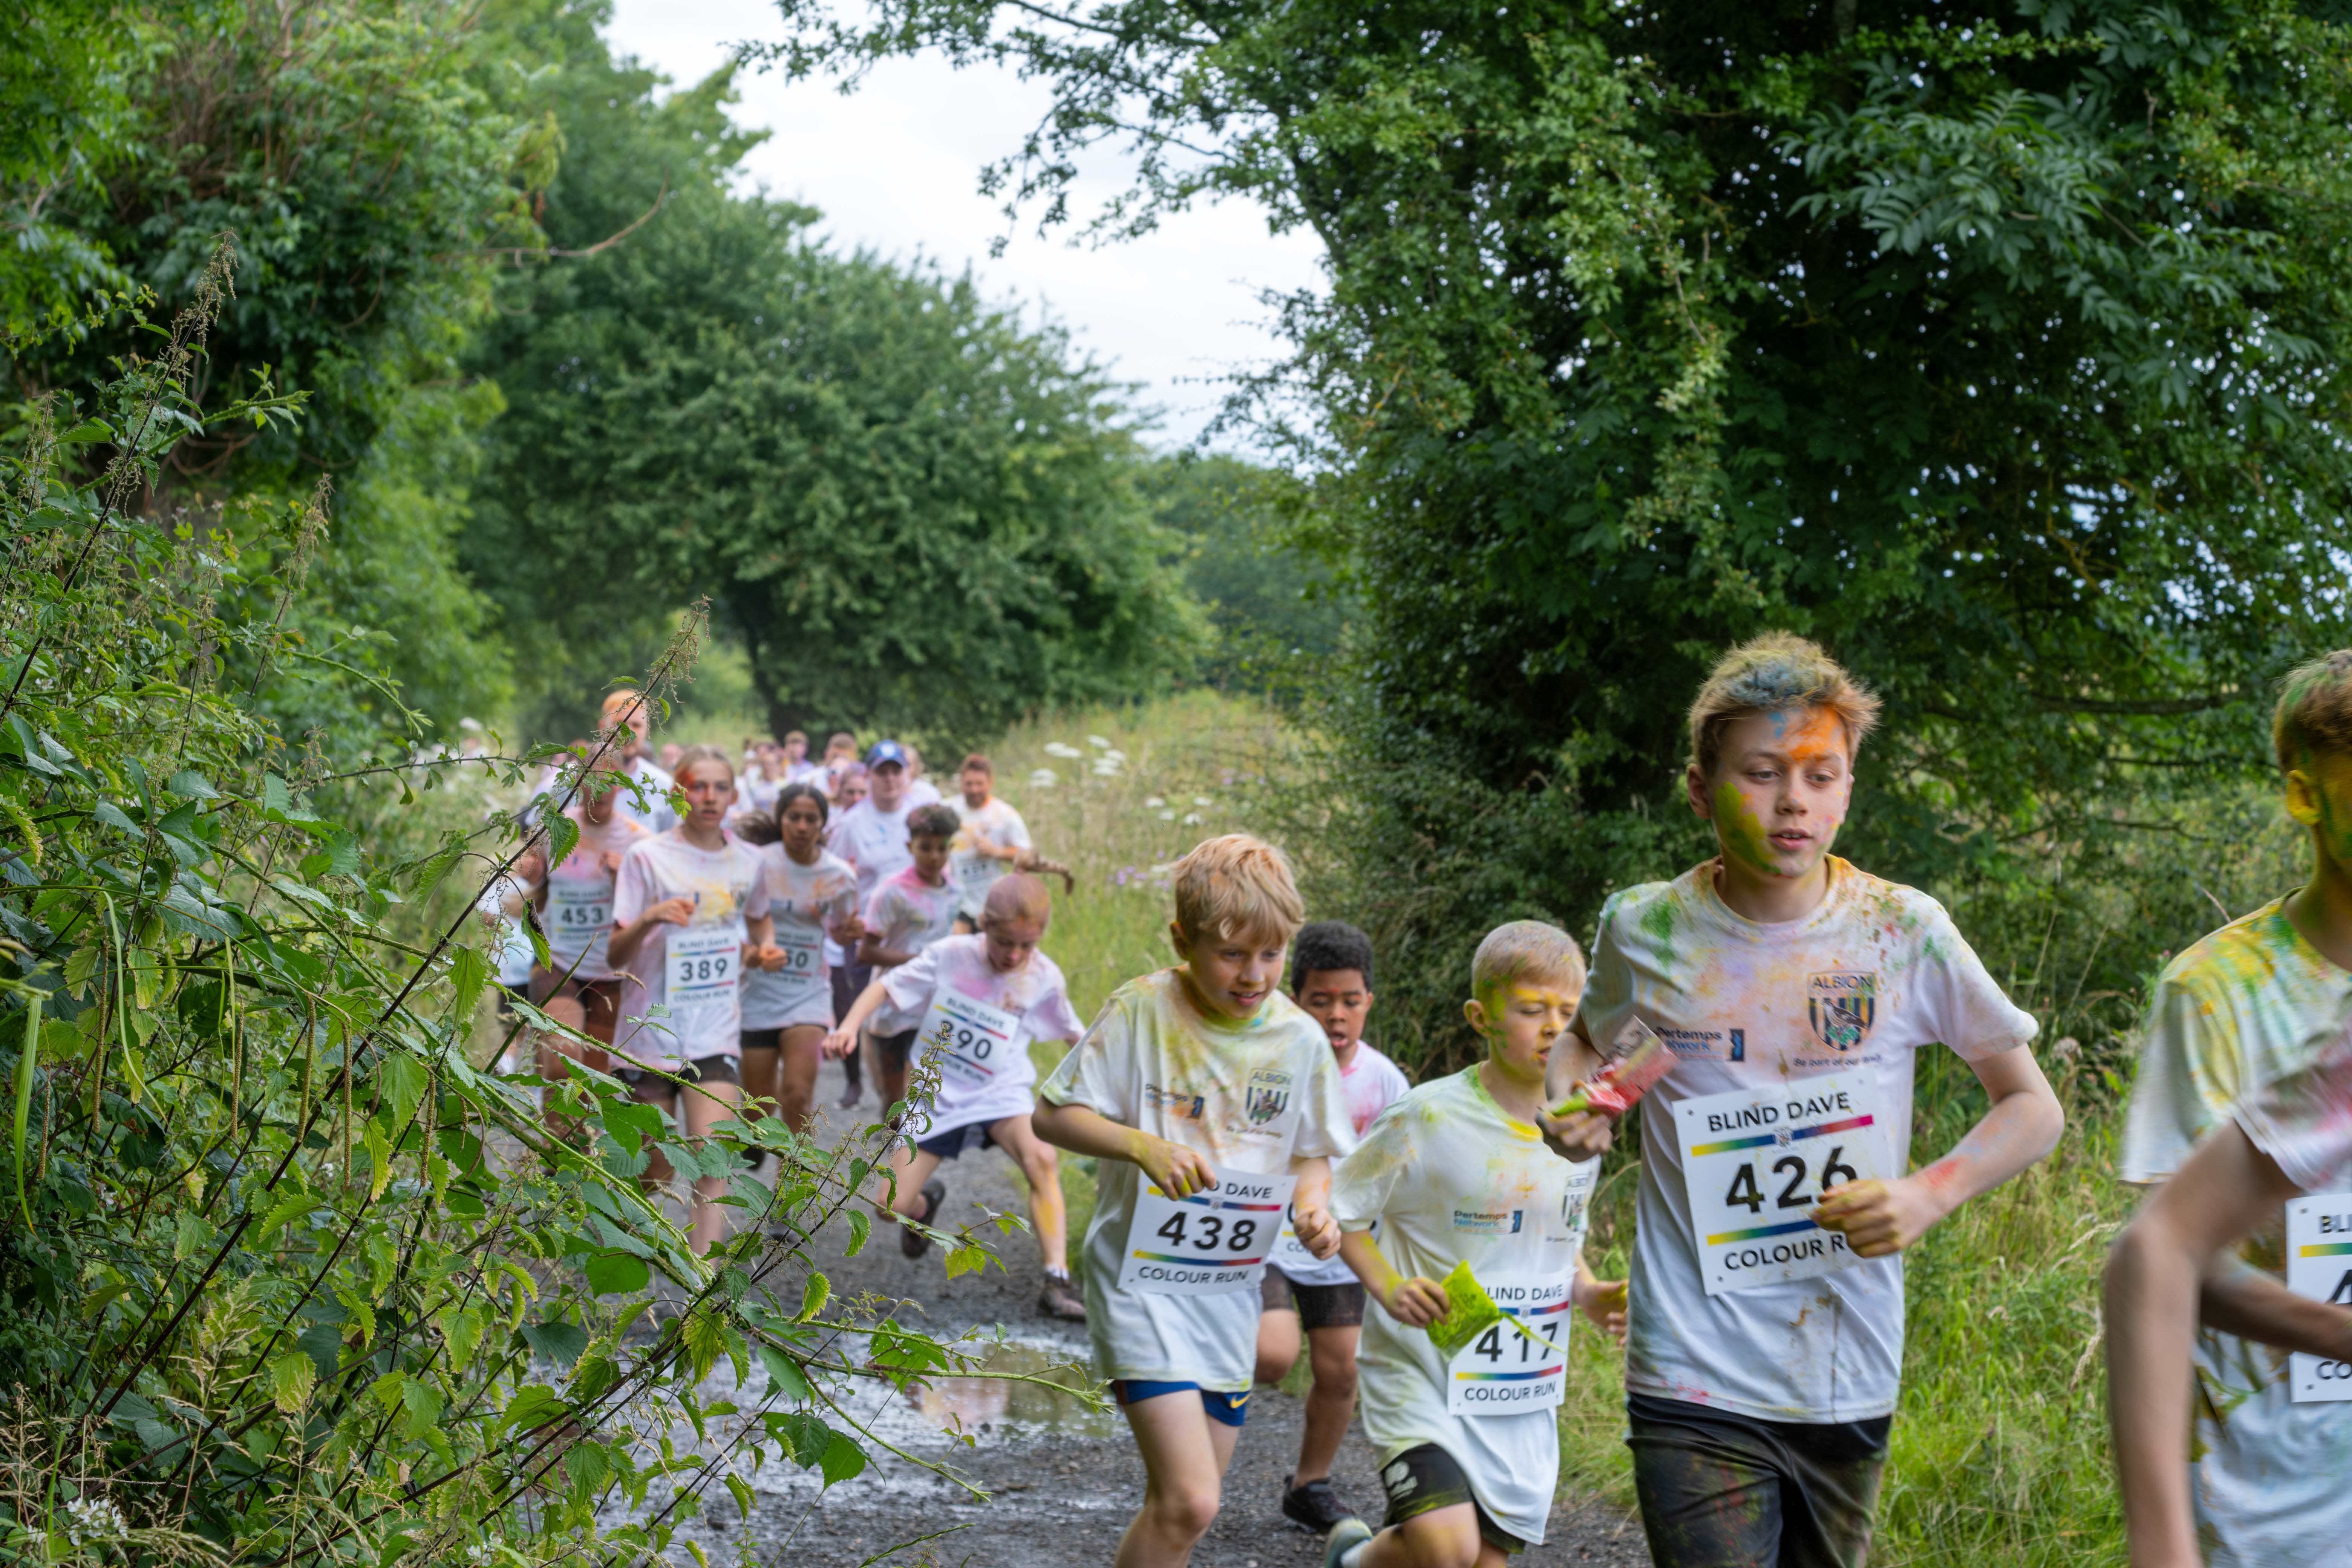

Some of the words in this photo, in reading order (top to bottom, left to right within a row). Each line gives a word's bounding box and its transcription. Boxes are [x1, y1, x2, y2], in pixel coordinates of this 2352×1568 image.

[561, 906, 603, 925] 453
[680, 958, 728, 982] 389
[1813, 975, 1874, 989] ALBION
[946, 997, 976, 1015] BLIND
[978, 1011, 1004, 1028] DAVE
[1707, 1105, 1779, 1132] BLIND
[1786, 1091, 1850, 1119] DAVE
[1726, 1145, 1858, 1214] 426
[1225, 1183, 1274, 1199] DAVE
[1455, 1210, 1507, 1222] Pertemps
[1156, 1211, 1257, 1251] 438
[1724, 1238, 1824, 1270] COLOUR
[1138, 1266, 1212, 1284] COLOUR
[1214, 1270, 1250, 1284] RUN
[1484, 1286, 1526, 1300] LIND
[1531, 1283, 1564, 1300] DAVE
[1474, 1321, 1559, 1363] 417
[1465, 1387, 1530, 1401] COLOUR
[1533, 1381, 1556, 1398] RUN
